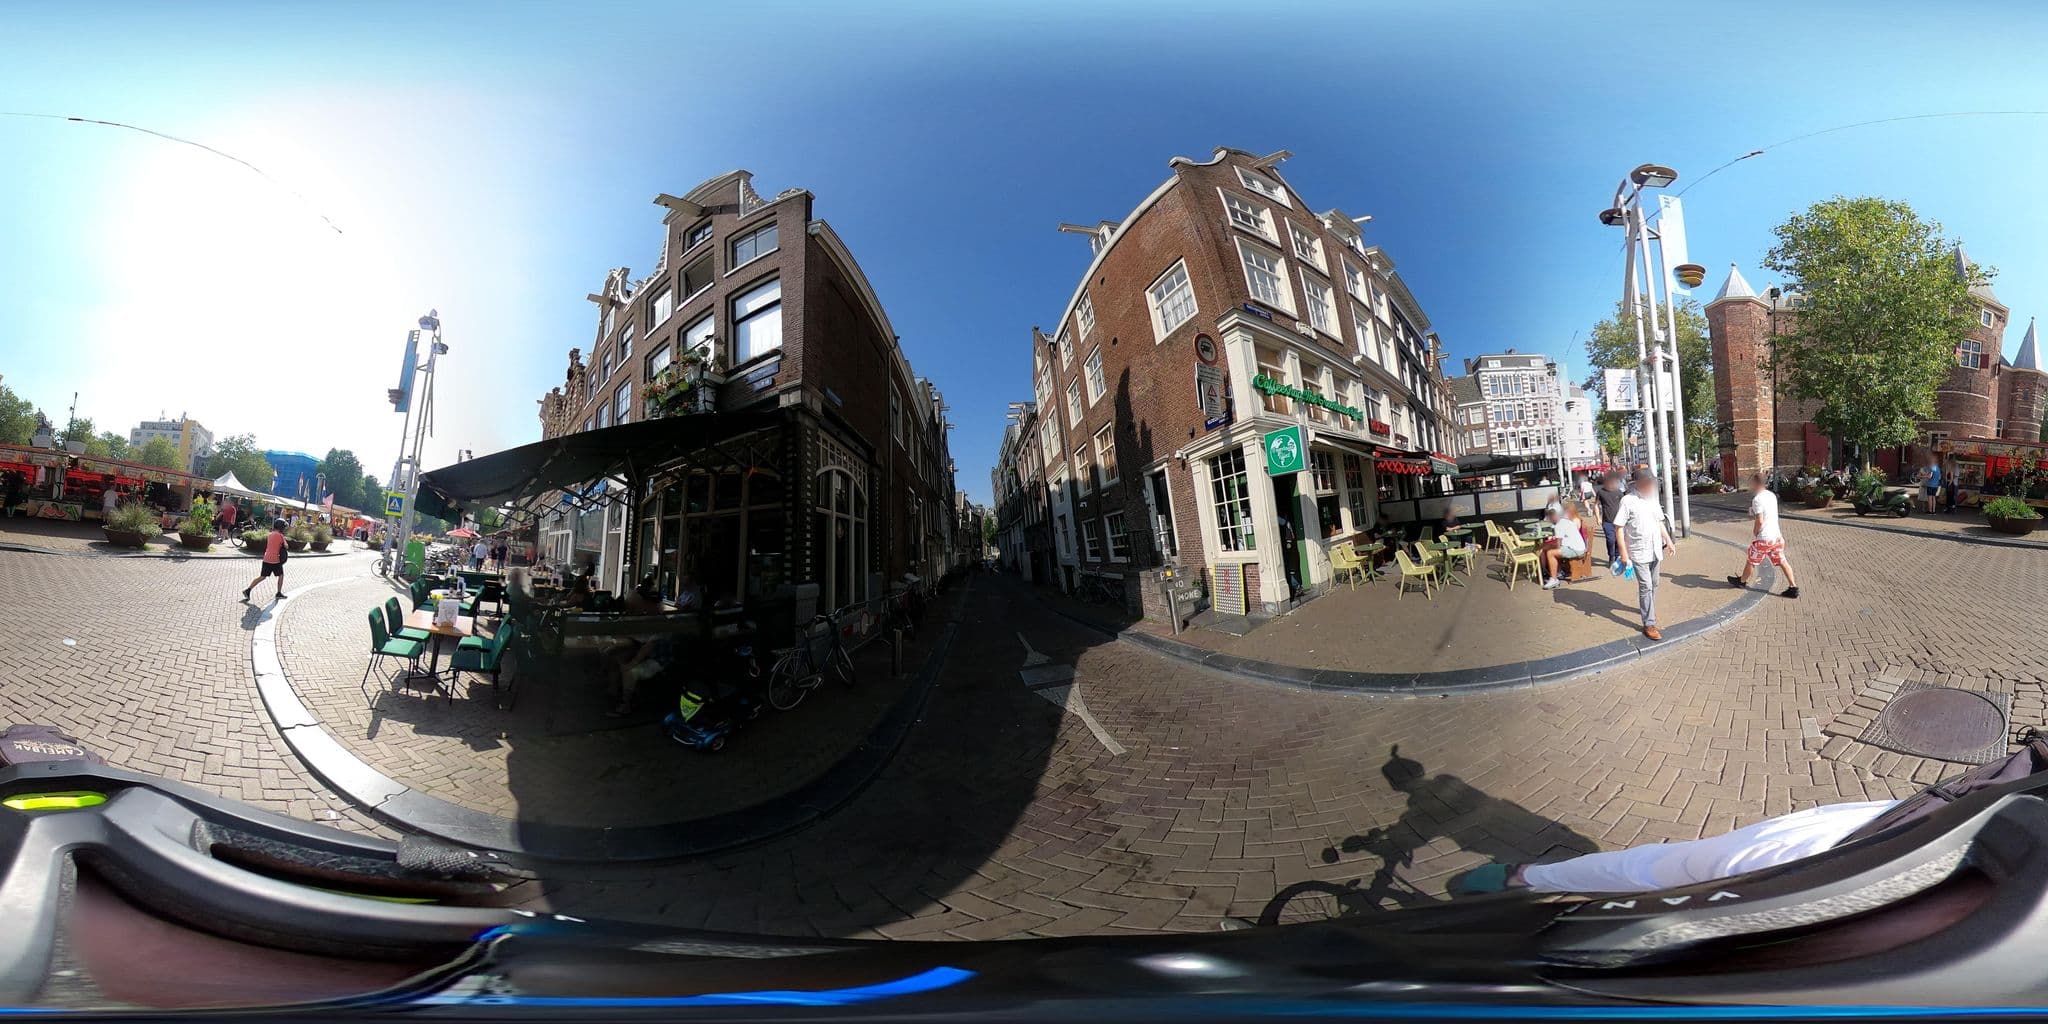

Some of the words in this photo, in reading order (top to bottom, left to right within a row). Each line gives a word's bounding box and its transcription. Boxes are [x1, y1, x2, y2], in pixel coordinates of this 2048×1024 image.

[1252, 373, 1303, 402] Coffeeshop
[1176, 589, 1200, 601] MOKE
[14, 743, 85, 756] CAMELBAK
